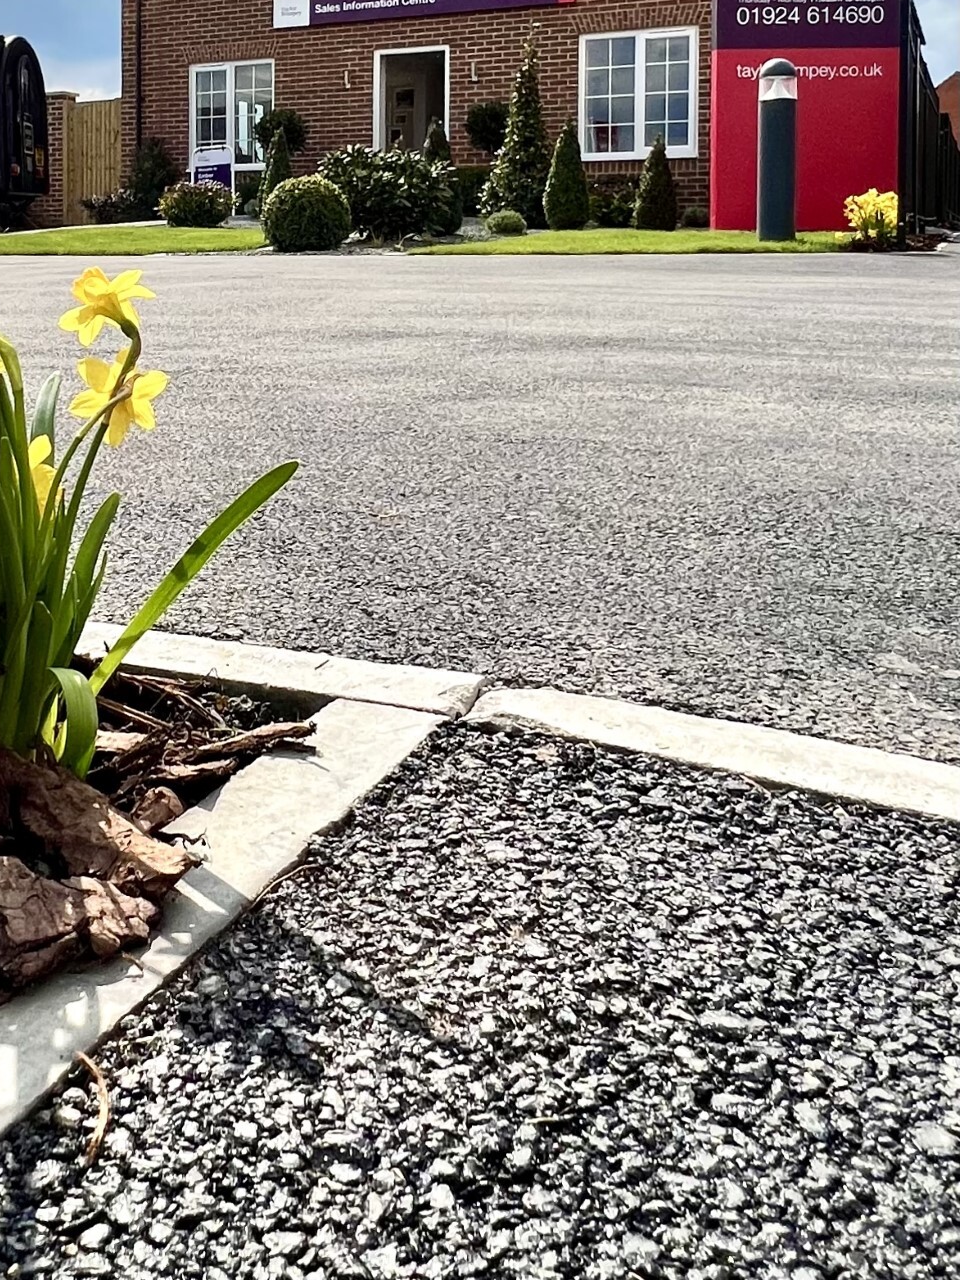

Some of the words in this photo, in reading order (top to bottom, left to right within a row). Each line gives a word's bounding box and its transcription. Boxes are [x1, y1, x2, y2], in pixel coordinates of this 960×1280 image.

[314, 3, 341, 14] Sales
[736, 6, 800, 25] 01924
[806, 5, 885, 24] 614690
[736, 62, 883, 80] taympey.co.uk
